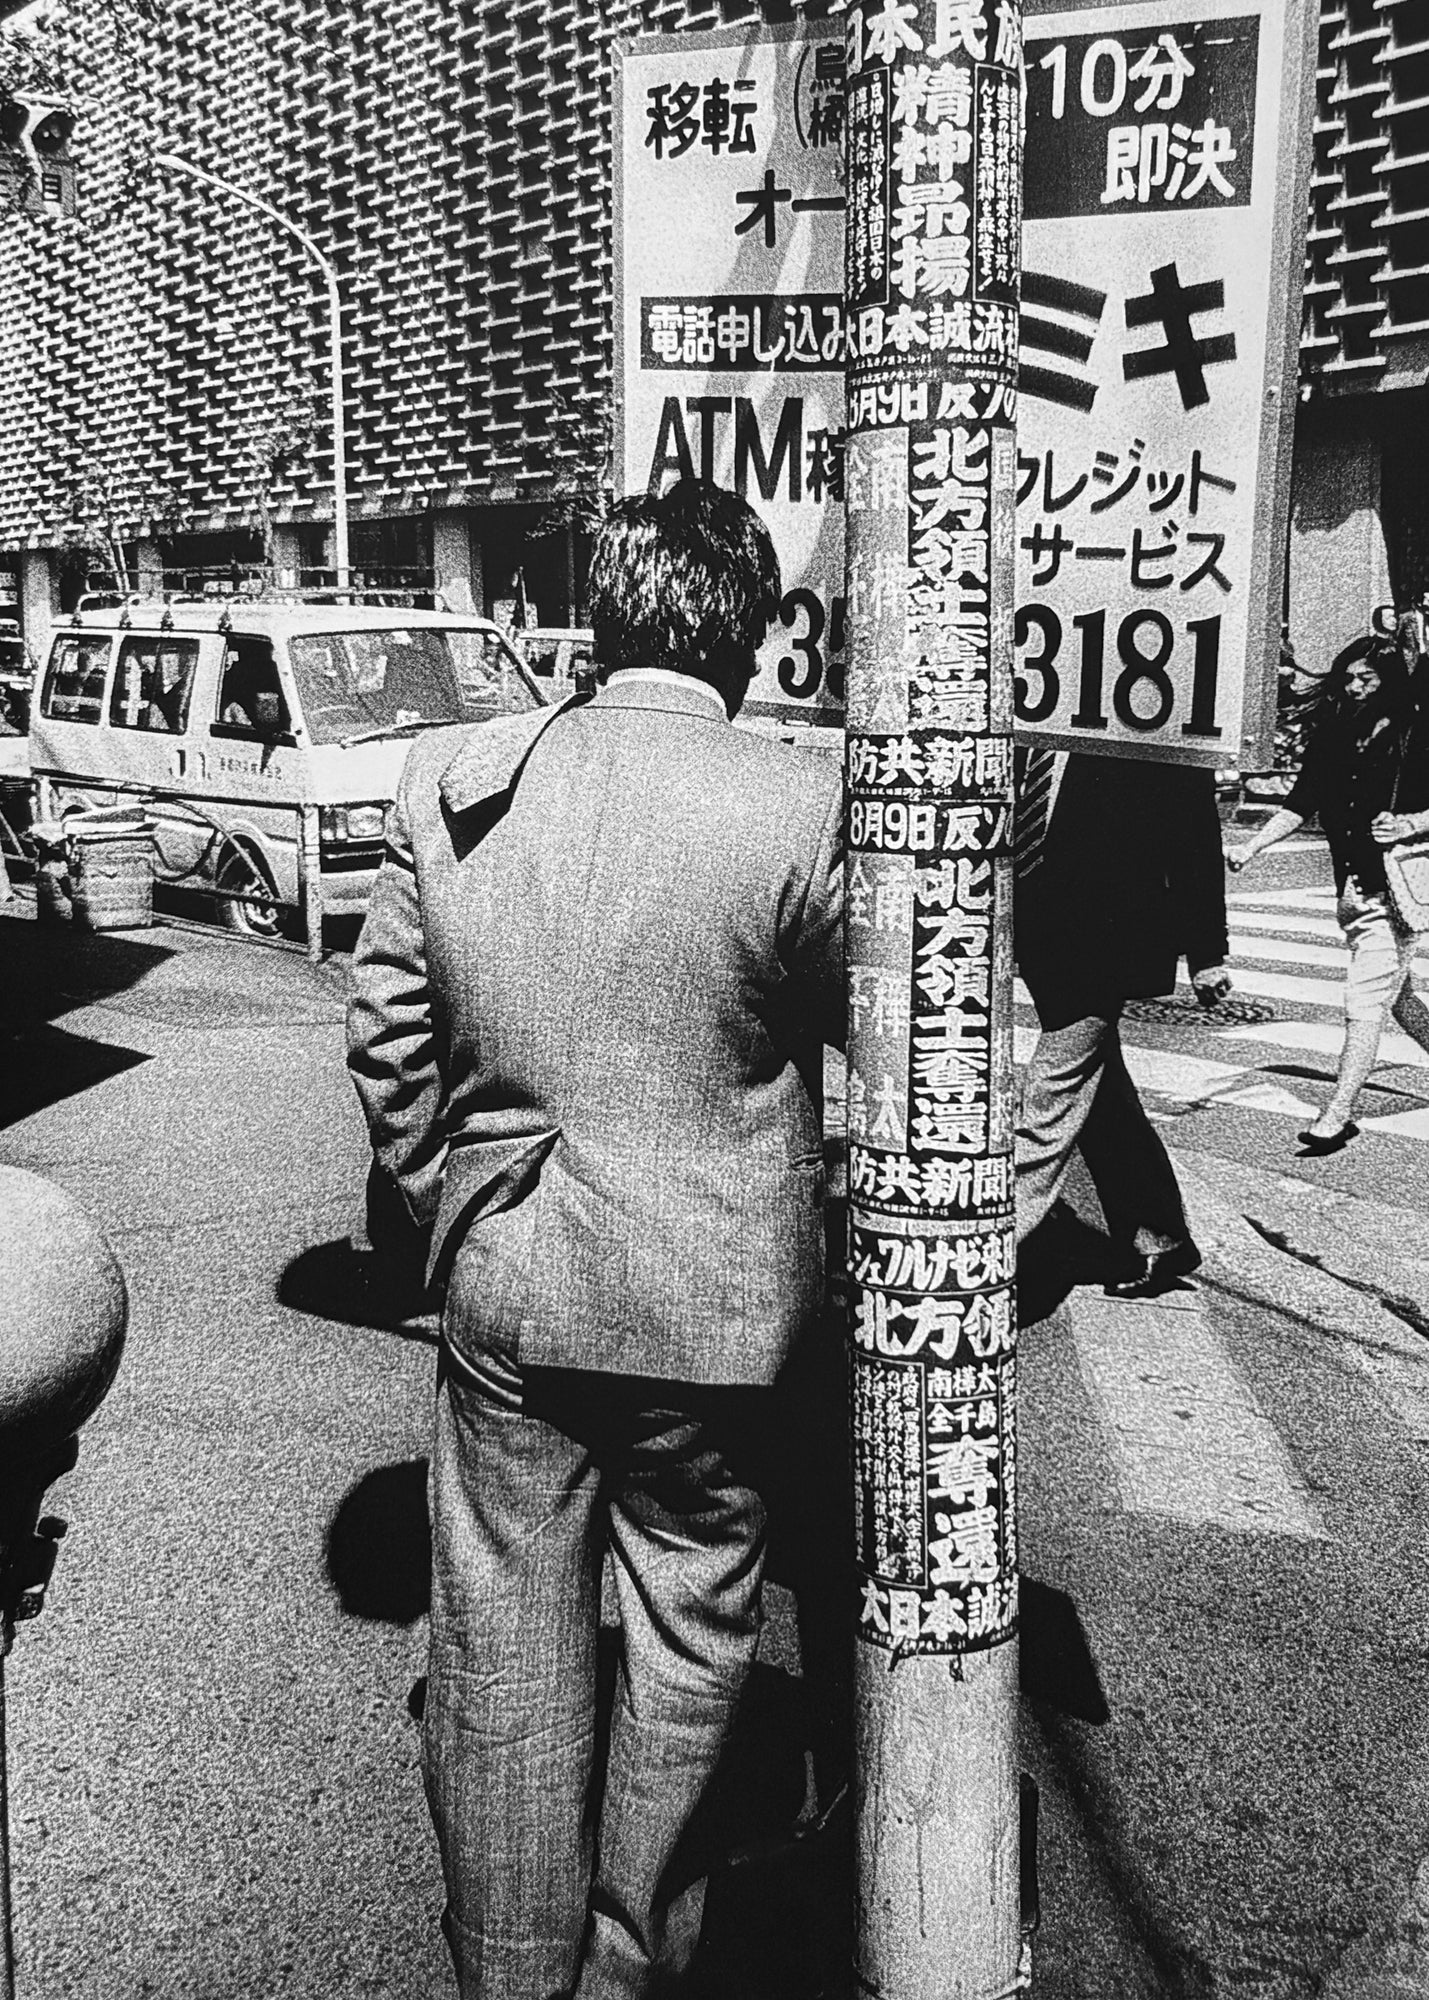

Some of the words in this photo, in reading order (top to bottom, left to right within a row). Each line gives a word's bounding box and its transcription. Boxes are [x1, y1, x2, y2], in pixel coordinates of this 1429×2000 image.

[1040, 33, 1196, 119] 10分
[644, 77, 757, 160] 移転
[1101, 118, 1237, 203] 即決
[648, 304, 846, 364] 電話申し込み
[1020, 519, 1234, 593] サービス
[1014, 603, 1223, 738] 3181
[854, 1289, 1017, 1360] 北方領
